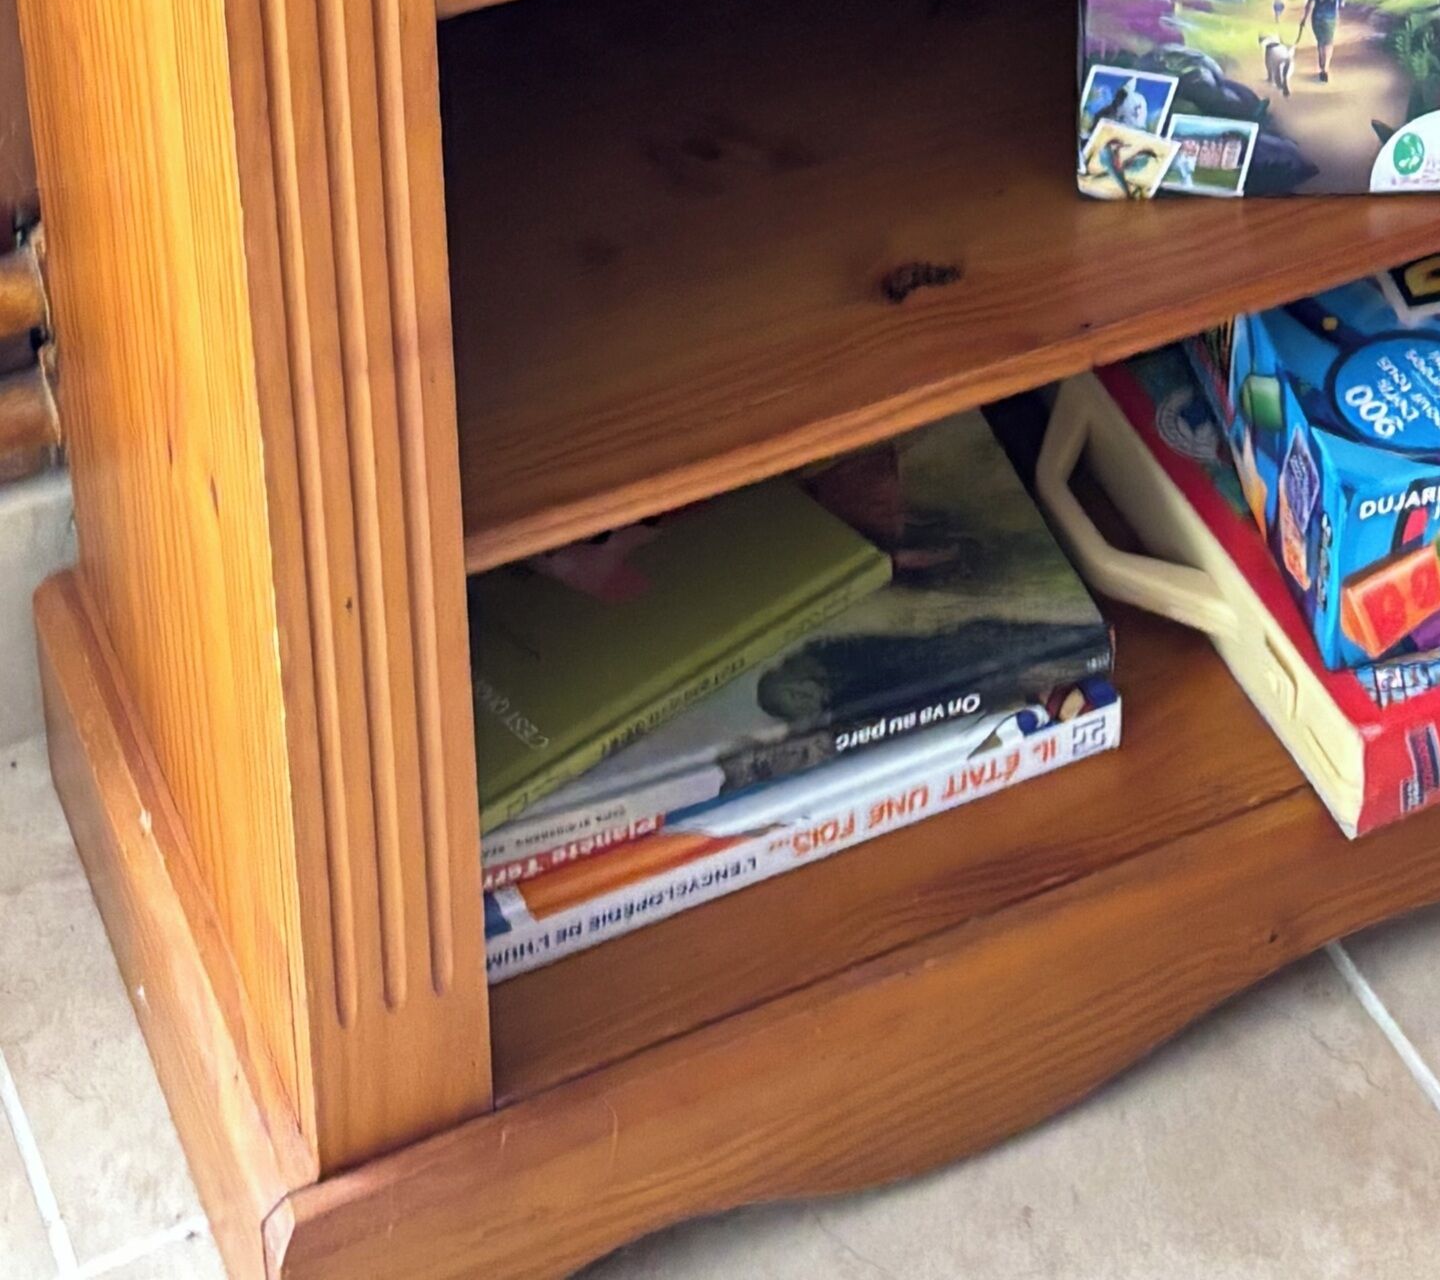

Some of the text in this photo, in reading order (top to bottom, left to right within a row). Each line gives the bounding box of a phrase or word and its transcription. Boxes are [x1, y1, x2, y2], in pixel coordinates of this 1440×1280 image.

[835, 692, 981, 752] On va au parc
[1033, 736, 1057, 763] IL
[941, 748, 1020, 800] ÉTAIT
[868, 785, 929, 830] UNE
[552, 811, 667, 864] Planète
[556, 921, 583, 944] DE
